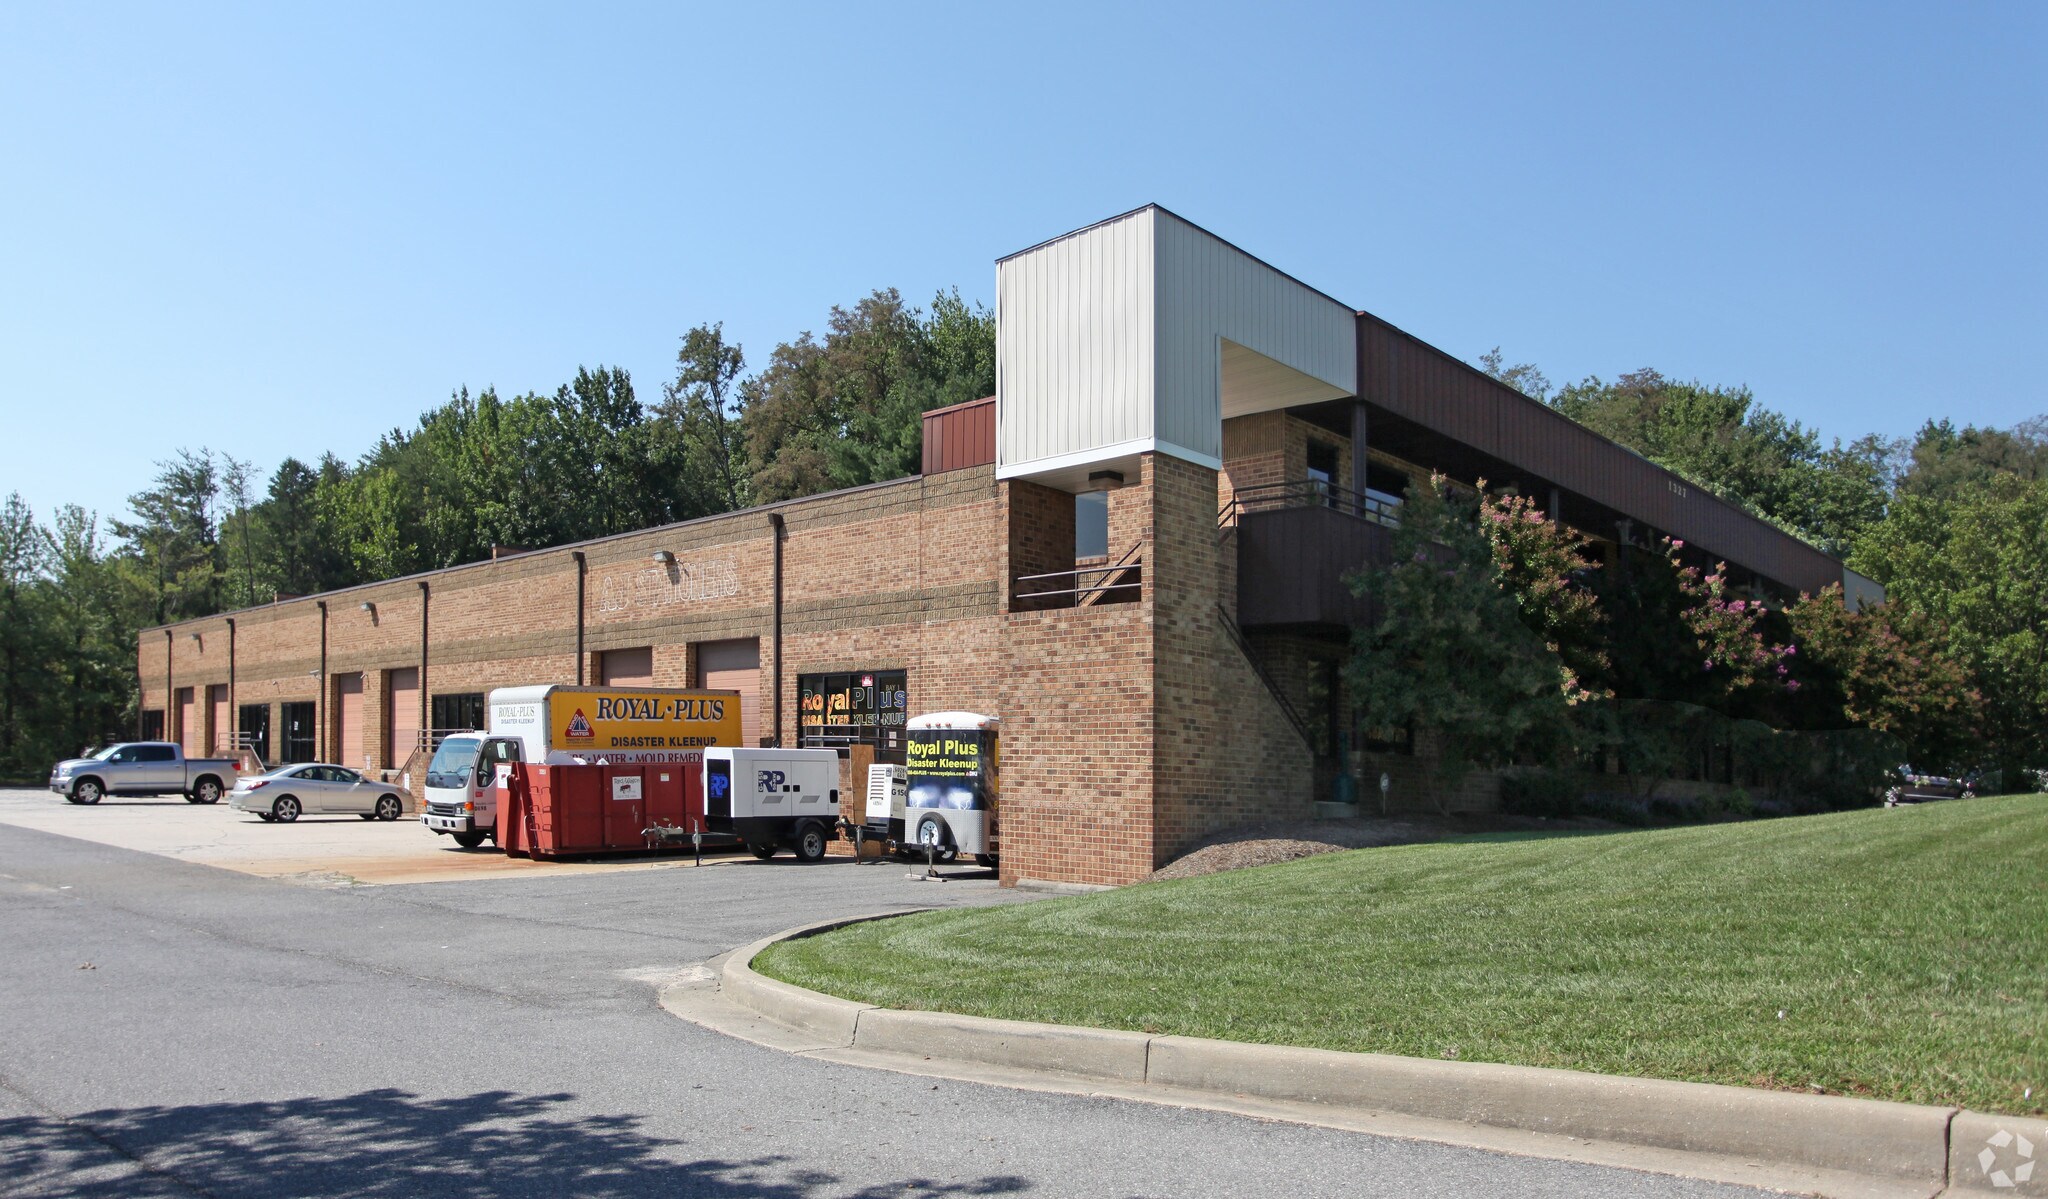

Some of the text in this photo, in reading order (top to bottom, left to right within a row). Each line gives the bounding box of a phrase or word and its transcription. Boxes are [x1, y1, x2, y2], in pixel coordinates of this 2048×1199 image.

[802, 687, 906, 715] Royal Plus
[499, 706, 535, 717] ROYAL PLUS
[595, 697, 724, 722] ROYAL PLUS
[802, 714, 850, 726] DISASTER
[611, 736, 717, 747] DISASTER KLEENUP
[907, 740, 978, 758] Royal Plus
[593, 753, 627, 763] WATER
[635, 753, 665, 763] MOLD
[907, 759, 978, 770] Disaster Kleenup
[758, 770, 786, 792] RP
